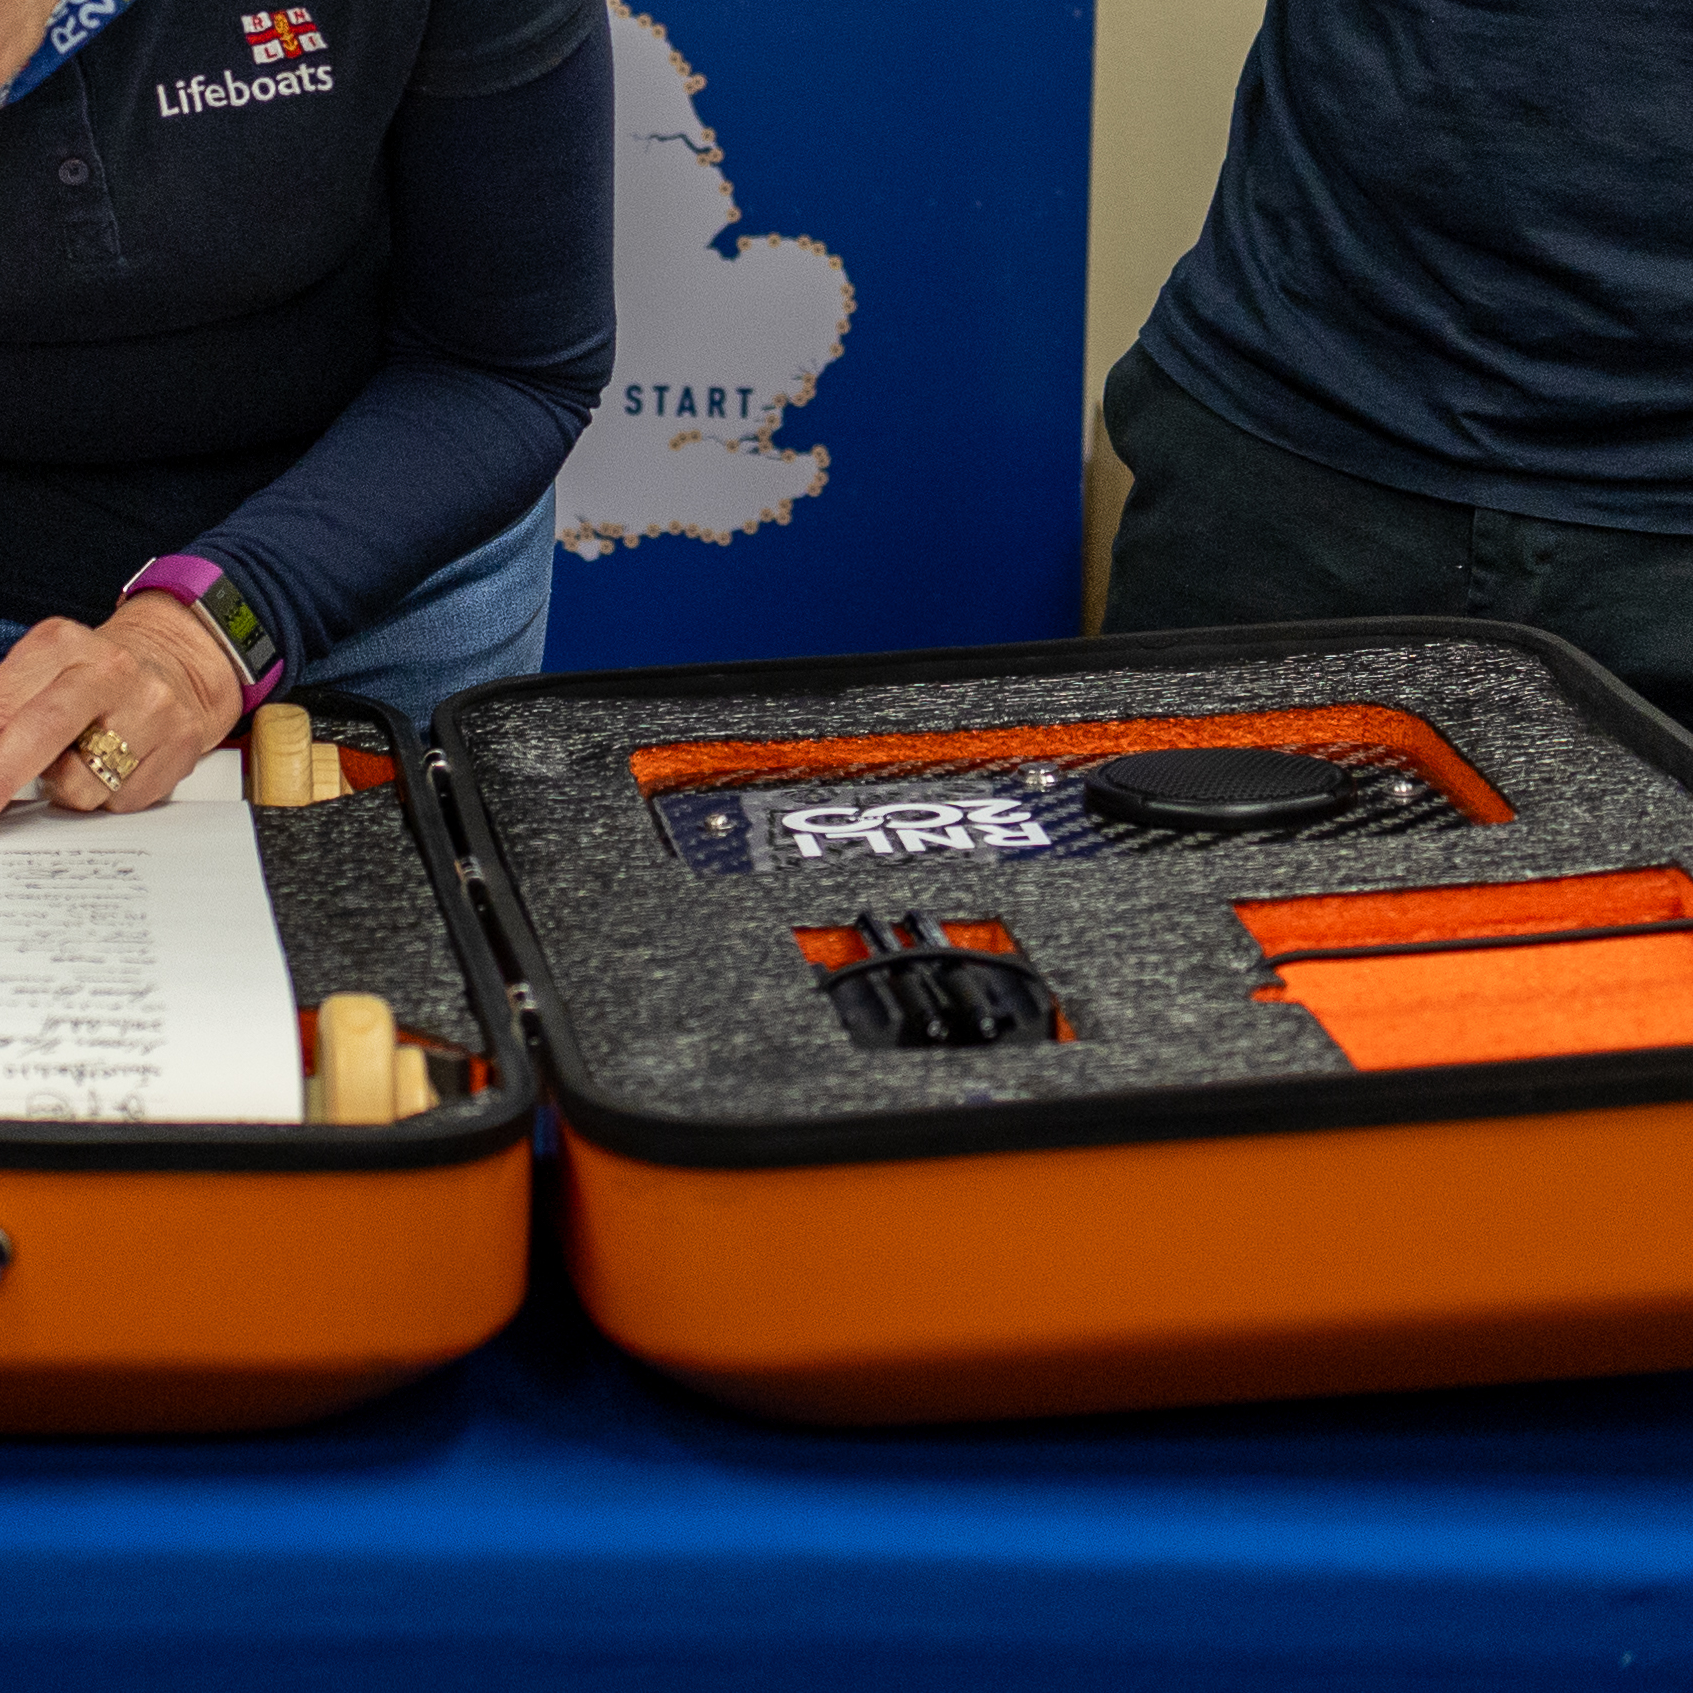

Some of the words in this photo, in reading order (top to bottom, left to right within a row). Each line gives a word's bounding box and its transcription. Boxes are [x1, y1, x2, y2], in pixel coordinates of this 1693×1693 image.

[156, 63, 334, 118] Lifeboats
[625, 384, 753, 419] START
[793, 821, 1053, 859] RNLI
